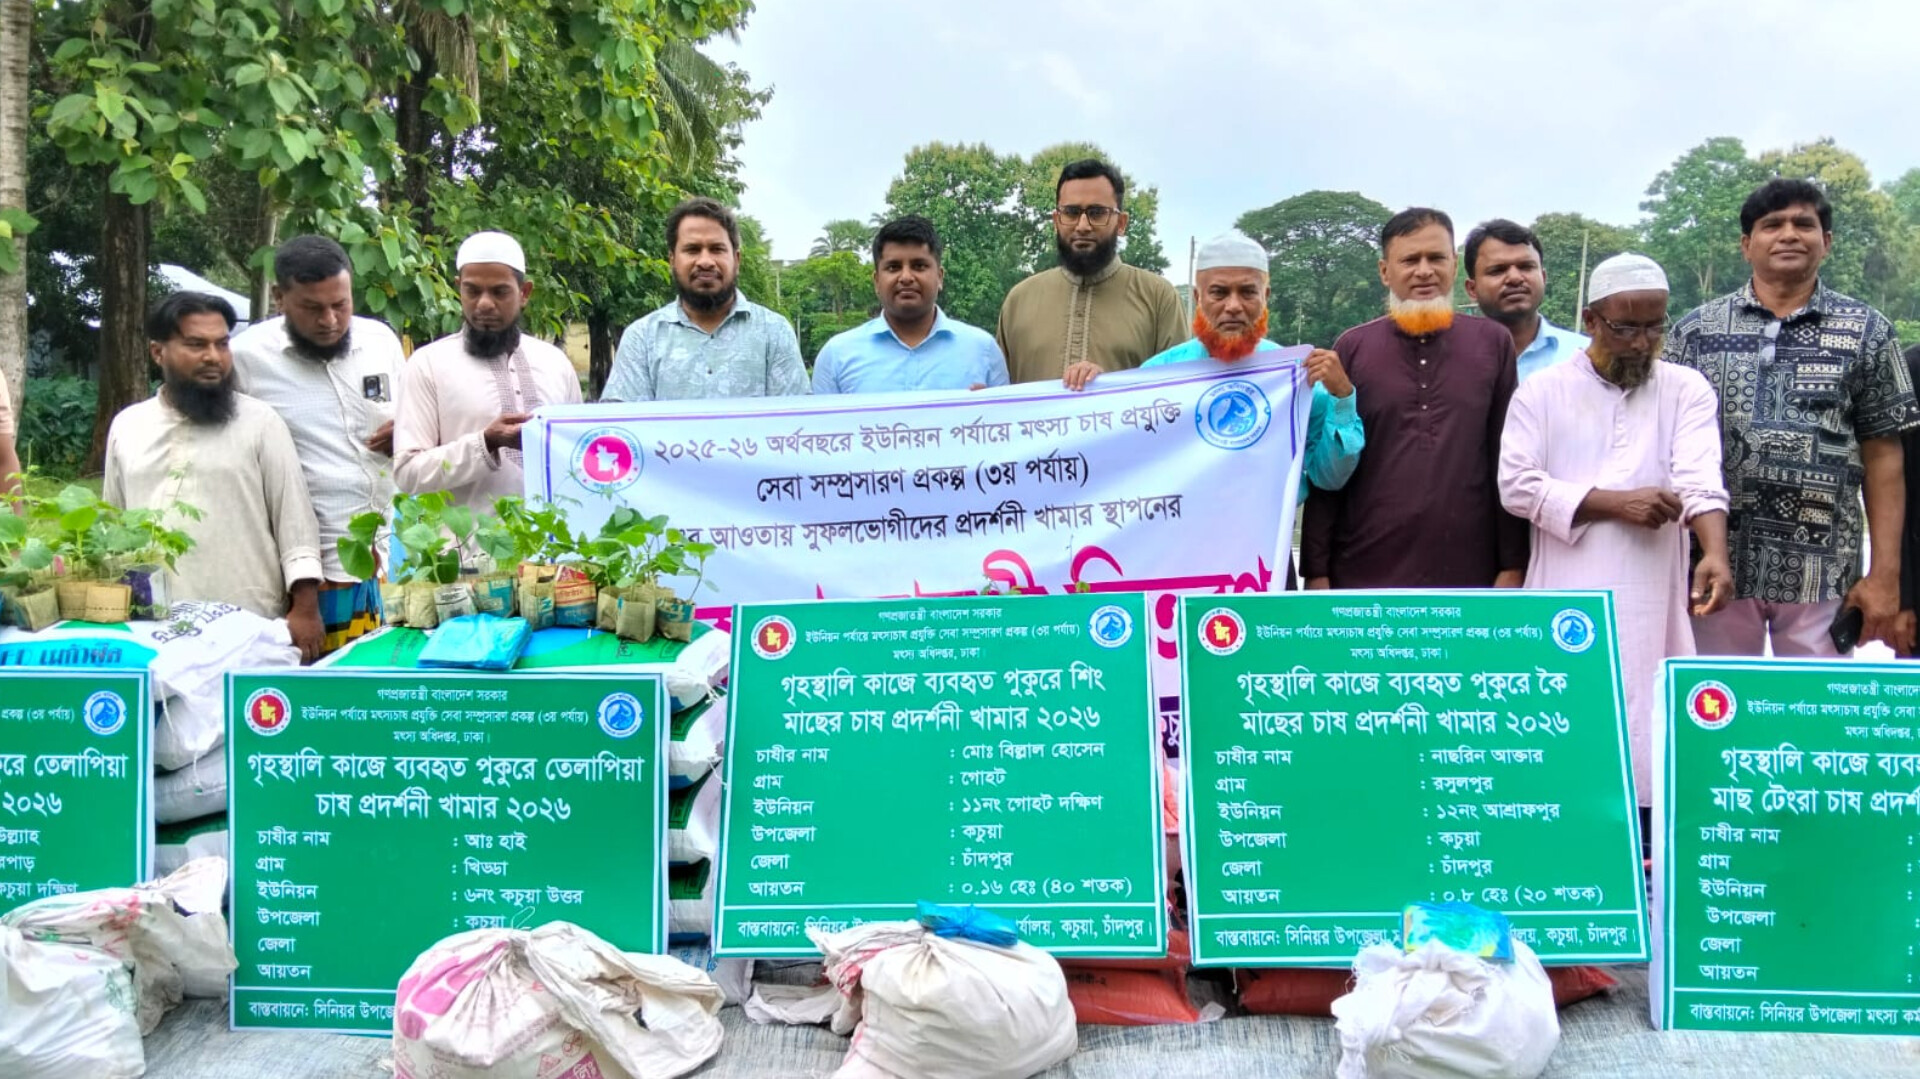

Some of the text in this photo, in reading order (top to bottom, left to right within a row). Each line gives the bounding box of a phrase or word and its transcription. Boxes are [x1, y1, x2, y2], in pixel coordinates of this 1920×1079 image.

[654, 438, 758, 465] ২০২৫-২৬
[766, 428, 854, 455] অর্থবছরে
[859, 422, 943, 453] ইউনিয়ন
[950, 416, 1012, 445] পর্যায়ে
[1018, 417, 1072, 438] মৎস্য
[1077, 412, 1113, 432] চাষ
[1121, 399, 1181, 434] প্রযুক্তি
[757, 448, 1089, 502] সেবা সম্প্রসারণ প্রকল্প (৩য় পর্যায়)
[710, 523, 795, 550] আওতায়
[800, 509, 950, 550] সুফলভোগীদের
[955, 501, 1028, 538] প্রদর্শনী
[1031, 500, 1094, 530] খামার
[1099, 494, 1184, 530] স্থাপনের
[781, 662, 1106, 704] গৃহস্থালি কাজে ব্যবহৃত পুকুরে শিং
[1237, 665, 1568, 705] গৃহস্থালি কাজে ব্যবহৃত পুকুরে কৈ
[783, 704, 1100, 735] মাছের চাষ প্রদর্শনী খামার ২০২৬
[1240, 704, 1570, 736] মাছের চাষ প্রদর্শনী খামার ২০২৬
[756, 745, 797, 763] চাষীর
[802, 748, 830, 762] নাম
[998, 741, 1045, 760] বিল্লাল
[1052, 742, 1105, 758] হোসেন
[1215, 747, 1258, 765] চাষীর
[1262, 750, 1292, 764] নাম
[1490, 749, 1544, 763] আক্তার
[1722, 742, 1920, 782] গৃহস্থালি কাজে ব্যব
[34, 748, 128, 778] তেলাপিয়া
[248, 747, 645, 787] গৃহস্থালি কাজে ব্যবহৃত পুকুরে তেলাপিয়া
[754, 774, 783, 789] গ্রাম
[1215, 776, 1493, 794] গ্রাম রসুলপুর
[3, 792, 62, 816] ২০২৬
[316, 786, 571, 822] চাষ প্রদর্শনী খামার ২০২৬
[753, 798, 814, 816] ইউনিয়ন
[963, 798, 1001, 812] ১১নং
[1058, 793, 1103, 810] দক্ষিণ
[1710, 781, 1920, 816] মাছ টেংরা চাষ প্রদর্শ
[1218, 801, 1282, 821] ইউনিয়ন
[1437, 804, 1479, 819] ১২নং
[257, 827, 298, 845] চাষীর
[303, 831, 331, 845] নাম
[498, 832, 528, 850] হাই
[751, 824, 1003, 843] উপজেলা কচুয়া
[1219, 829, 1481, 850] উপজেলা কচুয়া
[1700, 822, 1781, 843] চাষীর নাম
[256, 856, 286, 871] গ্রাম
[751, 848, 1014, 870] জেলা চাঁদপুর
[1222, 855, 1493, 877] জেলা চাঁদপুর
[1698, 854, 1731, 869] গ্রাম
[256, 880, 584, 909] ইউনিয়ন ৬নং কচুয়া উত্তর
[749, 882, 805, 896] আয়তন
[962, 880, 1003, 895] ০.১৬
[1043, 879, 1075, 897] (৪০
[1081, 877, 1132, 896] শতক)
[1222, 889, 1280, 904] আয়তন
[1443, 889, 1474, 902] ০.৮
[1515, 886, 1547, 904] (২০
[1553, 886, 1603, 904] শতক)
[1699, 878, 1767, 897] ইউনিয়ন
[257, 908, 320, 925] উপজেলা
[1706, 906, 1776, 926] উপজেলা
[258, 938, 296, 952] জেলা
[1284, 926, 1330, 945] সিনিয়র
[1700, 938, 1742, 952] জেলা
[257, 964, 312, 978] আয়তন
[1699, 964, 1759, 980] আয়তন
[314, 999, 356, 1018] সিনিয়র
[360, 1001, 394, 1020] উপজে
[1760, 1002, 1805, 1021] সিনিয়র
[1809, 1004, 1862, 1023] উপজেলা
[1866, 1009, 1898, 1024] মৎস্য
